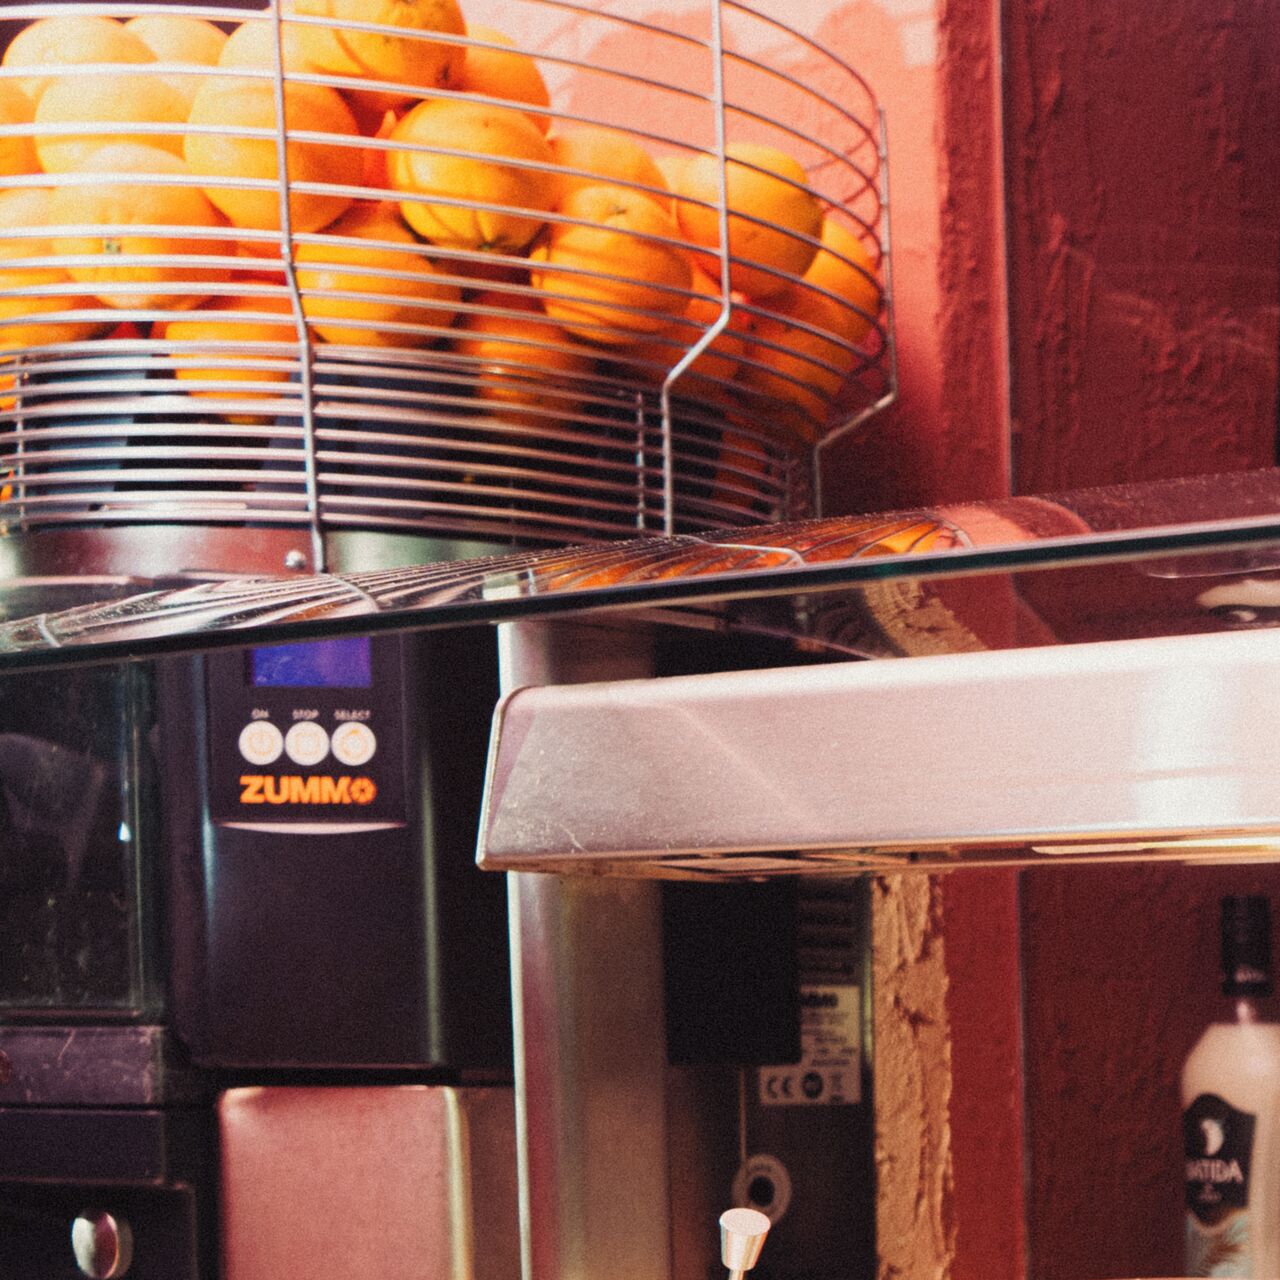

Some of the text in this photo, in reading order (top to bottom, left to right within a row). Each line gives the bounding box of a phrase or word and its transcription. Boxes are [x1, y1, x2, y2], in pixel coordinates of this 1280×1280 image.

[252, 709, 371, 721] ON STOP SELECT
[240, 775, 378, 805] ZUMMO
